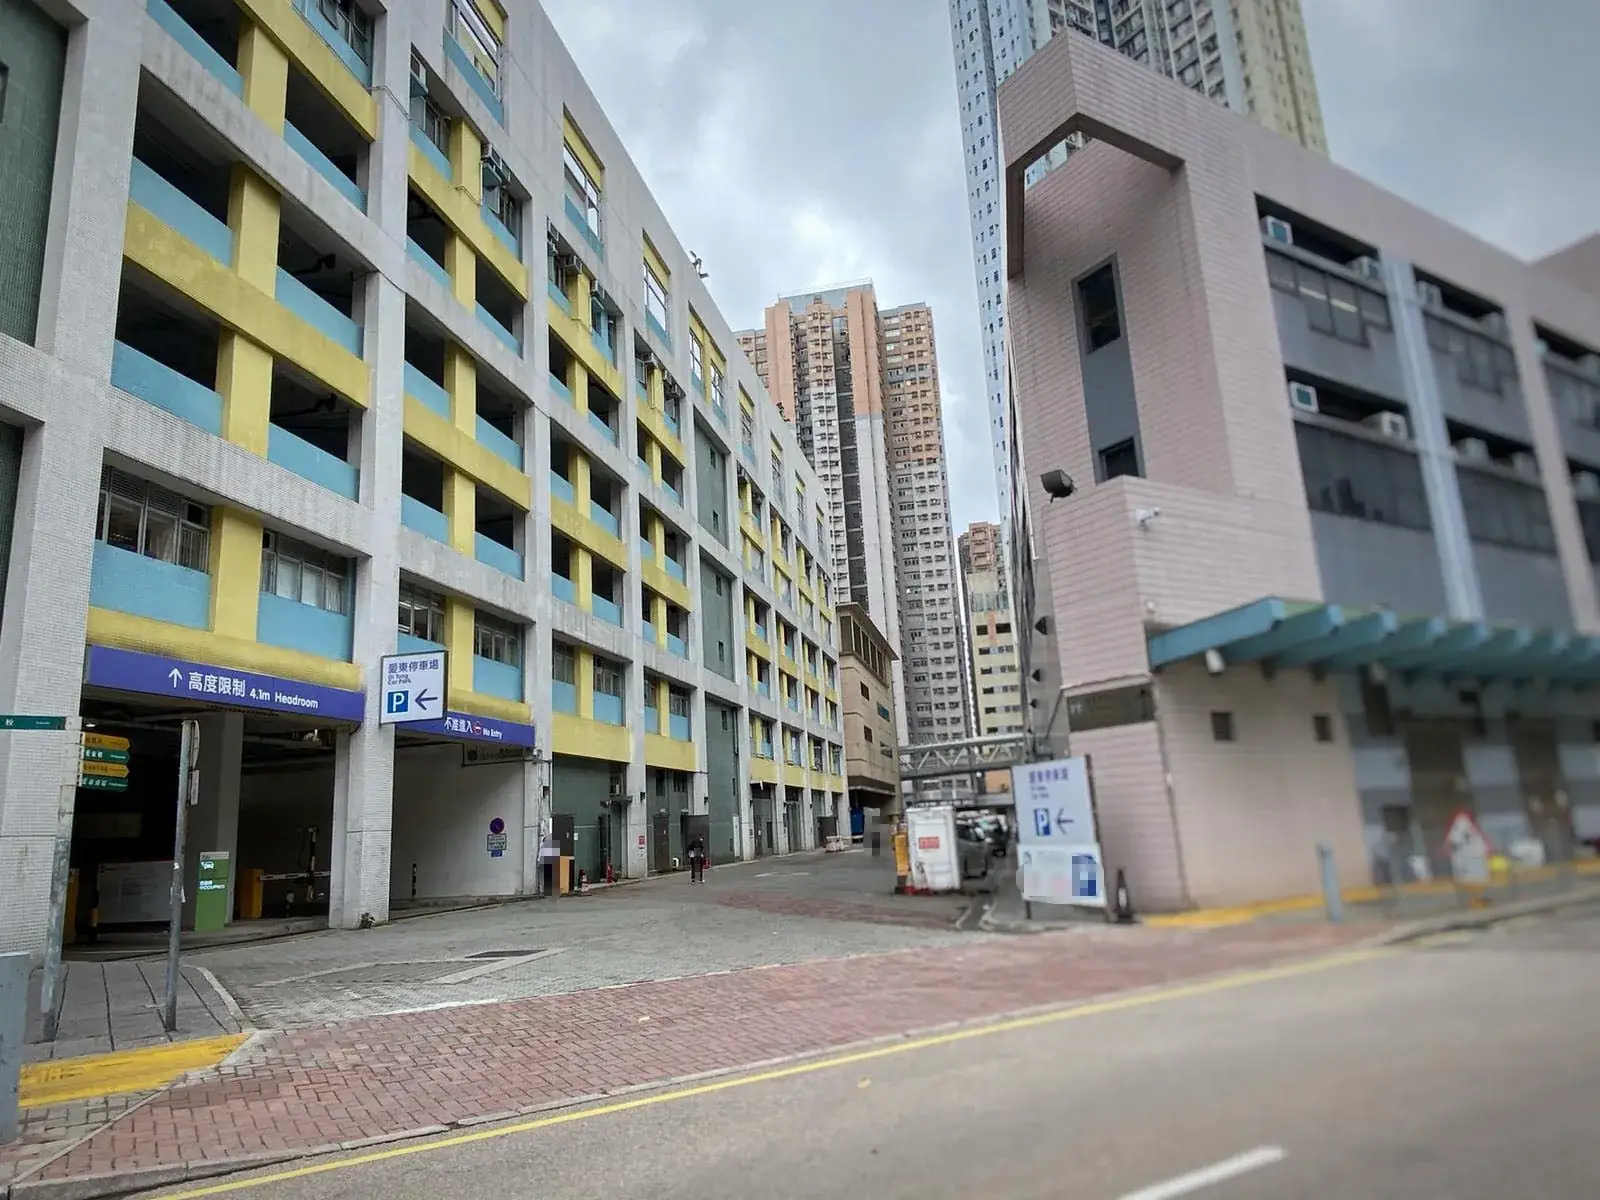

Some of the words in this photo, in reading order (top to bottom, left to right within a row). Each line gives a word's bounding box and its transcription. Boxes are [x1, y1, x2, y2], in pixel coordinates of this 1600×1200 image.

[189, 672, 245, 697] 高度限制
[250, 688, 270, 701] 4.1m
[275, 691, 319, 709] Headroom
[393, 693, 404, 712] P
[483, 728, 490, 736] No
[491, 729, 502, 740] Entry
[1036, 809, 1048, 836] P
